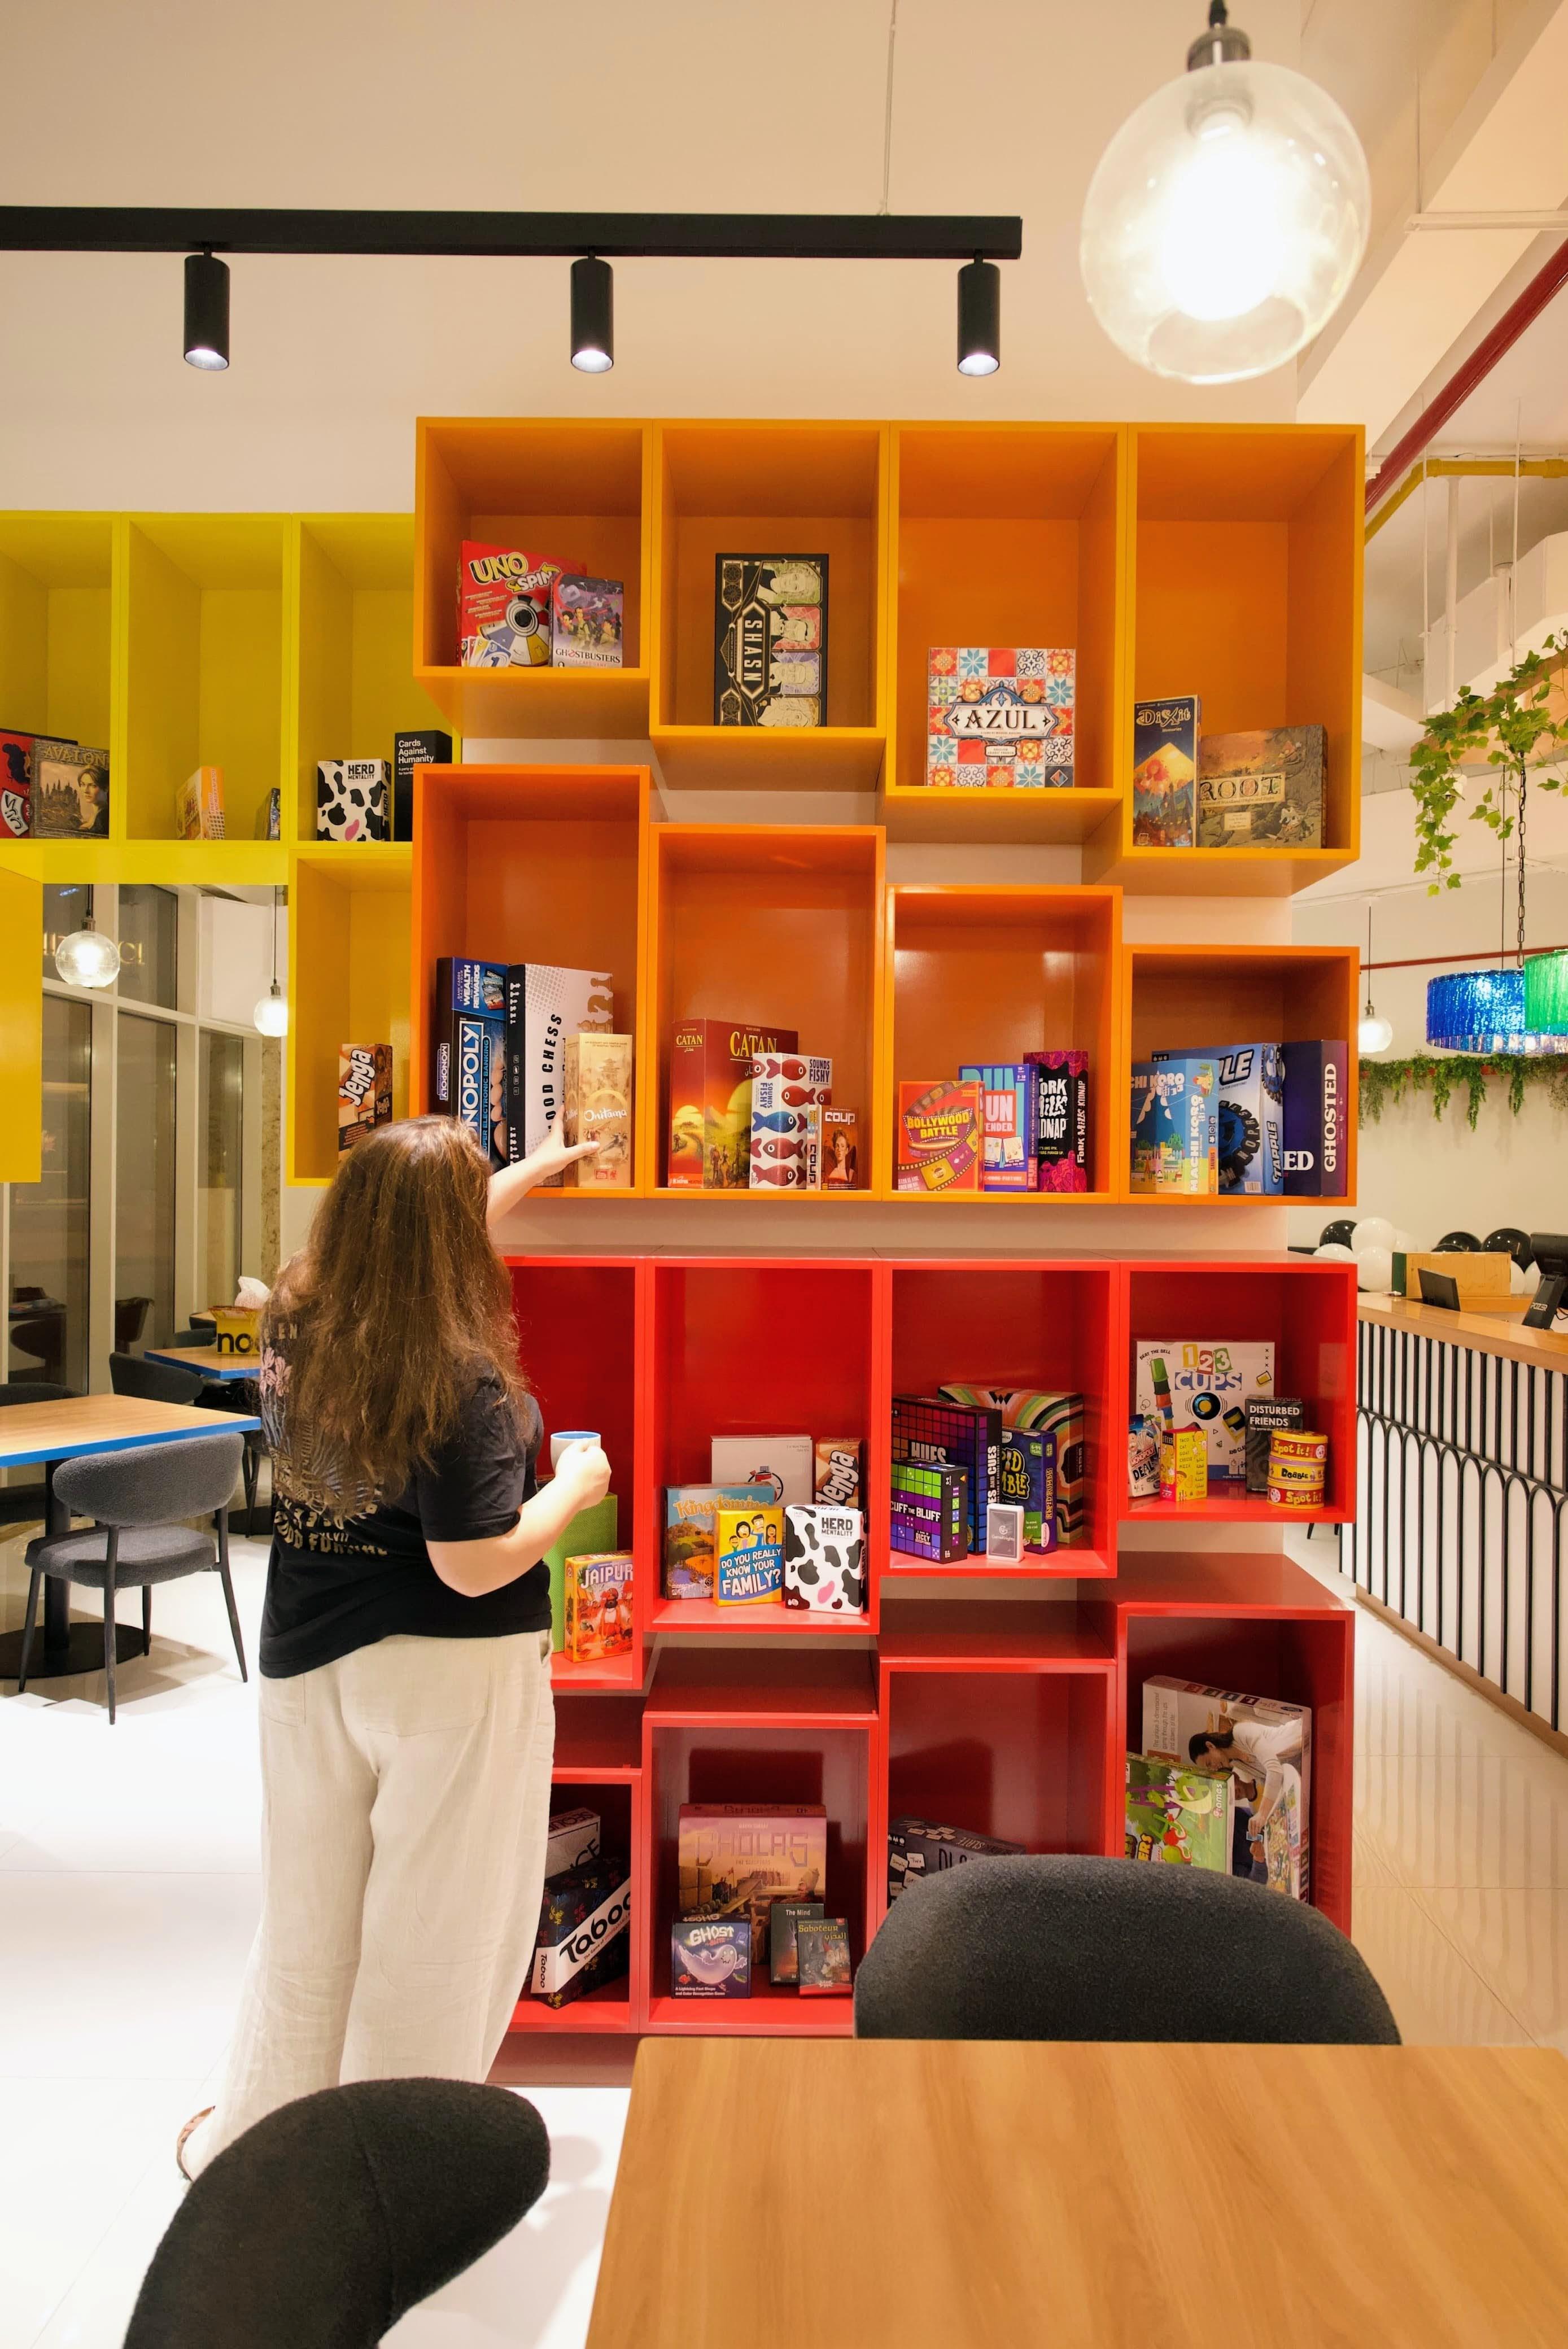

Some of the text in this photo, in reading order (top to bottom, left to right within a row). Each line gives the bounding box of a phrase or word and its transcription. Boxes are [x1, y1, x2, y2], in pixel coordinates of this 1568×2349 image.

[470, 552, 527, 584] UNO
[556, 648, 620, 663] GHOSTBUSTERS
[744, 619, 762, 682] SHASN
[965, 709, 1036, 729] AZUL
[399, 739, 421, 748] Cards
[399, 746, 427, 757] Against
[45, 745, 108, 766] AVALON
[398, 754, 434, 763] Humanity
[348, 764, 374, 775] HERD
[1200, 775, 1282, 801] ROOT
[542, 1014, 562, 1073] CHESS
[676, 1035, 703, 1045] CATAN
[730, 1031, 777, 1057] CATAN
[809, 1059, 829, 1069] SOUNDS
[339, 1049, 375, 1107] Jenga
[462, 1025, 479, 1130] NOPOLY
[809, 1069, 829, 1082] FISHY
[1150, 1073, 1185, 1089] KORO
[1039, 1078, 1067, 1096] ORK
[584, 1107, 627, 1121] Onitama
[986, 1095, 1014, 1121] UN
[907, 1112, 970, 1129] BOLLYWOOD
[1324, 1063, 1337, 1172] GHOSTED
[920, 1125, 958, 1138] BATTLE
[985, 1123, 1014, 1132] ENDED.
[1190, 1095, 1199, 1193] MACHI KORO
[1267, 1121, 1282, 1184] TAPPLE
[1176, 1372, 1242, 1391] CUPS
[1250, 1405, 1300, 1416] DISTURBED
[1250, 1417, 1289, 1426] FRIENDS
[1131, 1447, 1155, 1466] MONOPOLY
[1273, 1440, 1310, 1456] Spot it!
[988, 1446, 997, 1474] CUES
[816, 1450, 859, 1506] Jenga
[1133, 1460, 1154, 1481] DEAL
[1286, 1491, 1312, 1505] Spot
[916, 1507, 941, 1522] BLUFF
[822, 1517, 853, 1531] HERD
[915, 1532, 931, 1542] DICEY
[720, 1547, 781, 1569] DO YOU REALLY
[581, 1562, 633, 1589] JAIPUR
[726, 1560, 775, 1578] KNOW YOUR
[722, 1569, 781, 1596] FAMILY?
[689, 1926, 734, 1946] GHOST
